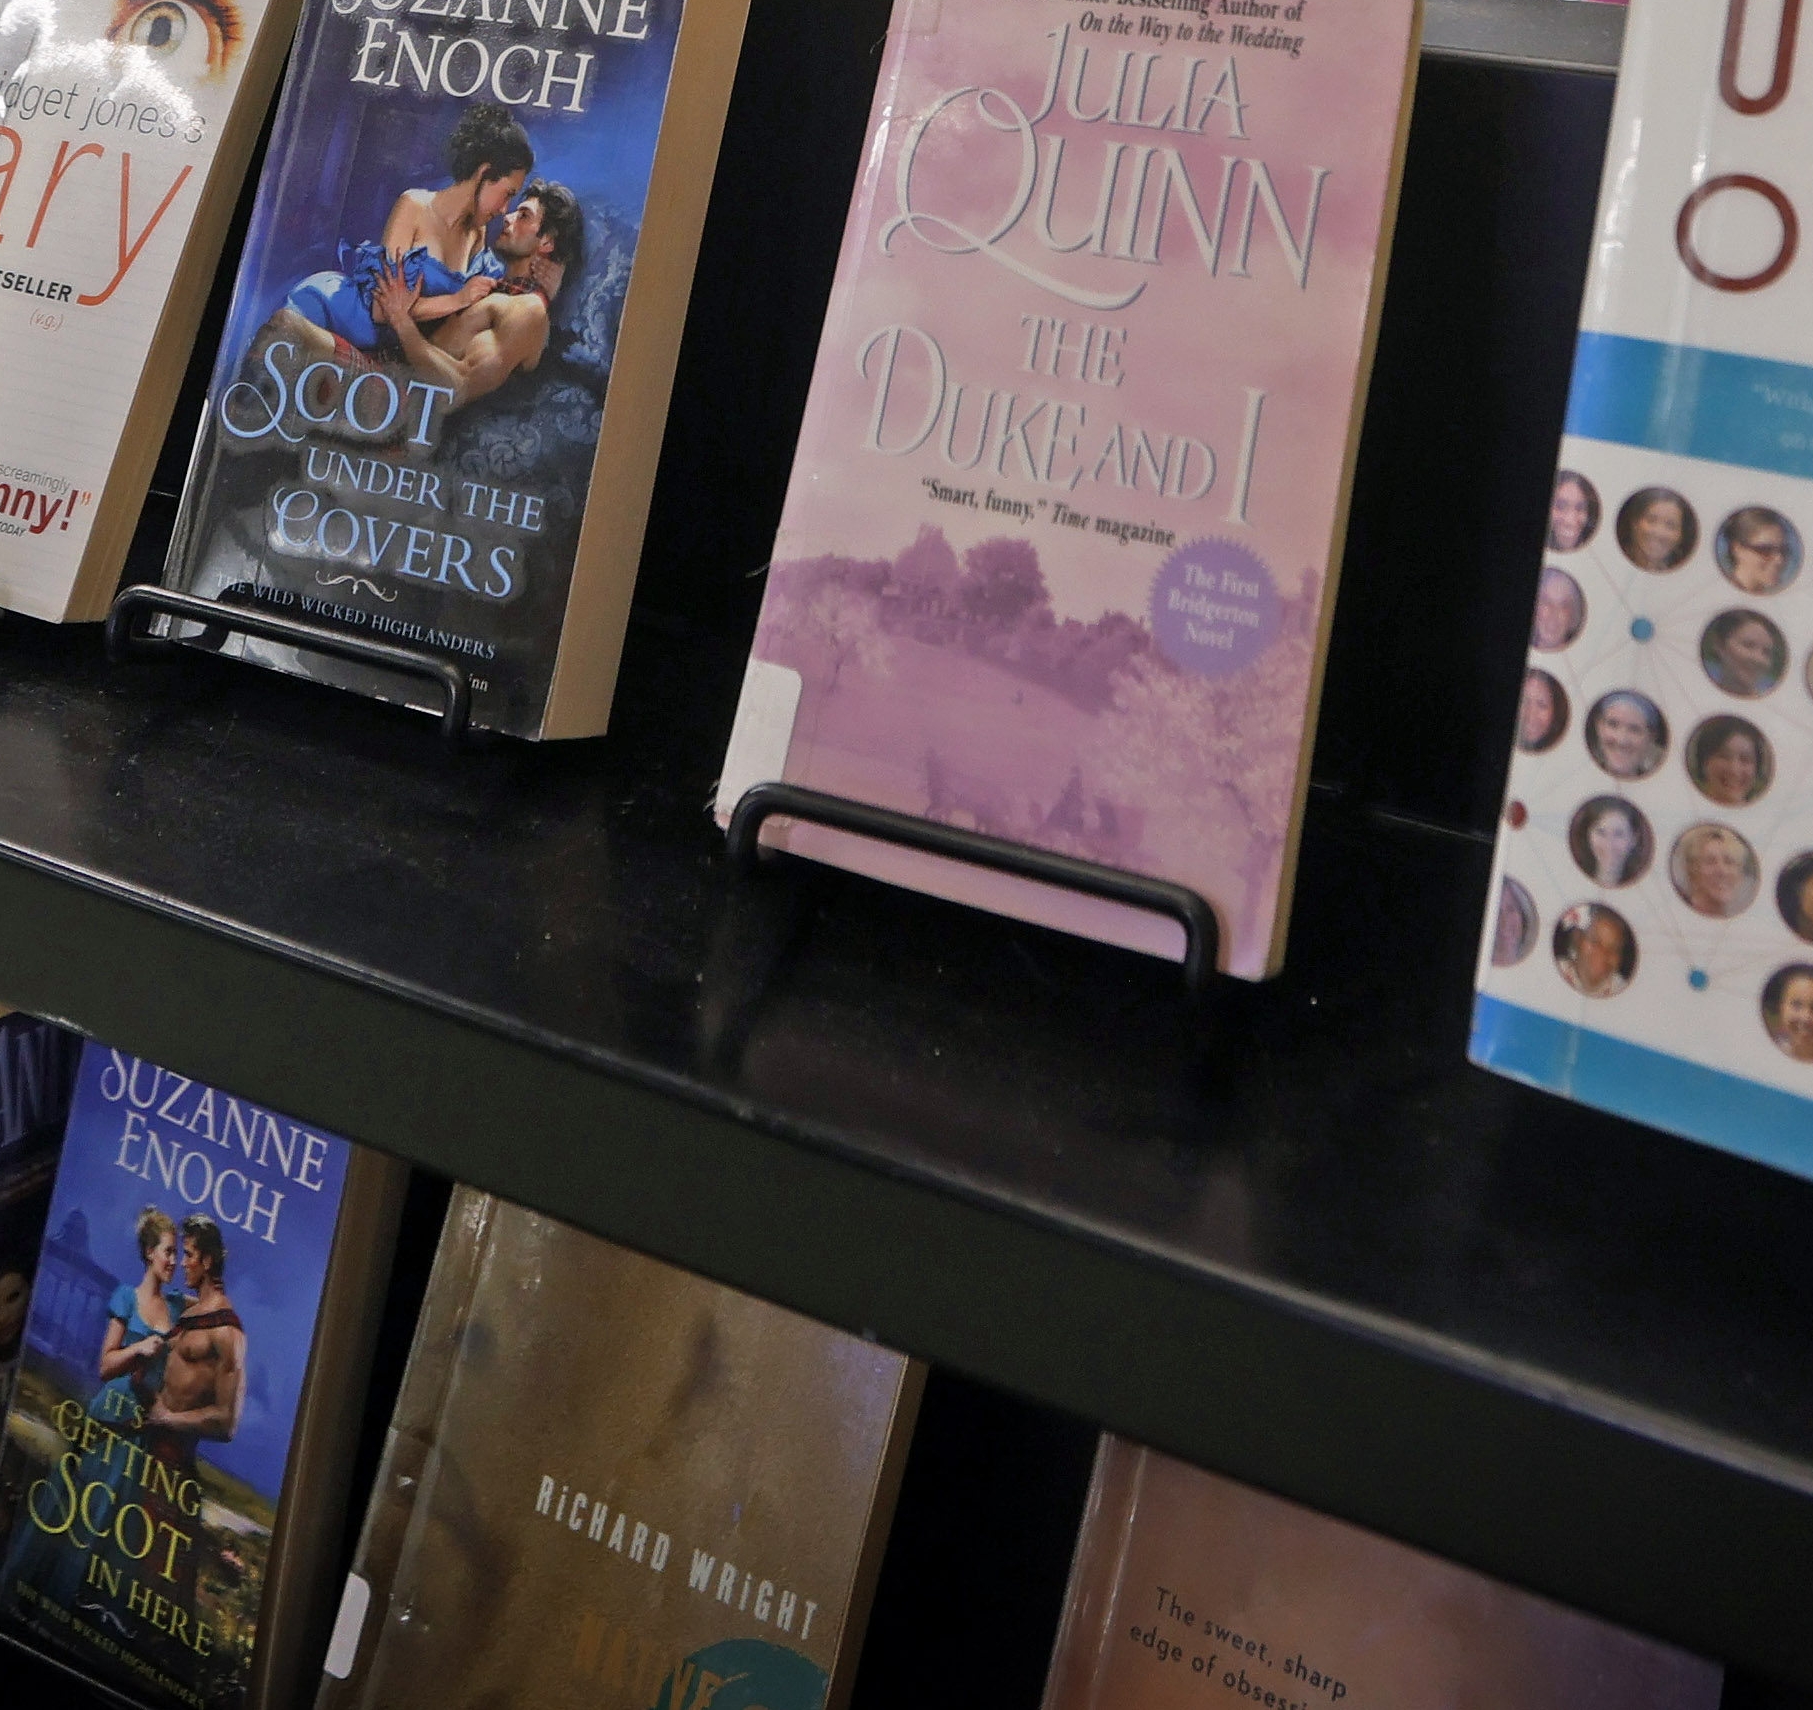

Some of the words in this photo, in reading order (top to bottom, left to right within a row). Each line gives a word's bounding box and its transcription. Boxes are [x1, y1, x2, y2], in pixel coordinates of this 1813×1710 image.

[349, 16, 596, 115] ENOCH
[1047, 23, 1252, 140] JULIA
[1079, 10, 1103, 33] On
[1107, 12, 1134, 36] the
[1139, 15, 1173, 46] Way
[1176, 20, 1194, 44] to
[1196, 19, 1224, 45] the
[1229, 23, 1306, 59] Wedding
[79, 87, 207, 144] joness
[878, 86, 1334, 312] QUINN
[220, 340, 456, 447] SCOT
[1021, 312, 1130, 389] THE
[856, 324, 1088, 492] DUKE
[1093, 422, 1219, 502] AND
[1225, 386, 1270, 529] I
[307, 446, 447, 512] UNDER
[460, 480, 546, 533] THE
[1051, 502, 1092, 531] Time
[1095, 516, 1177, 550] magazine
[272, 485, 518, 599] COVERS
[1184, 561, 1217, 590] The
[1220, 568, 1262, 600] First
[251, 583, 296, 610] WILD
[300, 594, 367, 627] WICKED
[371, 614, 497, 661] HIGHLANDERS
[1167, 588, 1263, 631] Bridgerton
[1183, 619, 1236, 652] Novel
[99, 1047, 329, 1192] SUZANNE
[114, 1109, 287, 1245] ENOCH
[51, 1399, 204, 1517] GETTING
[103, 1389, 145, 1430] IT'S
[28, 1451, 193, 1584] SCOT
[87, 1553, 124, 1598] IN
[126, 1579, 215, 1658] HERE
[1130, 1625, 1183, 1662] edge
[1191, 1654, 1219, 1678] of
[1156, 1585, 1195, 1626] The
[1203, 1619, 1273, 1668] sweet,
[1284, 1654, 1347, 1702] sharp
